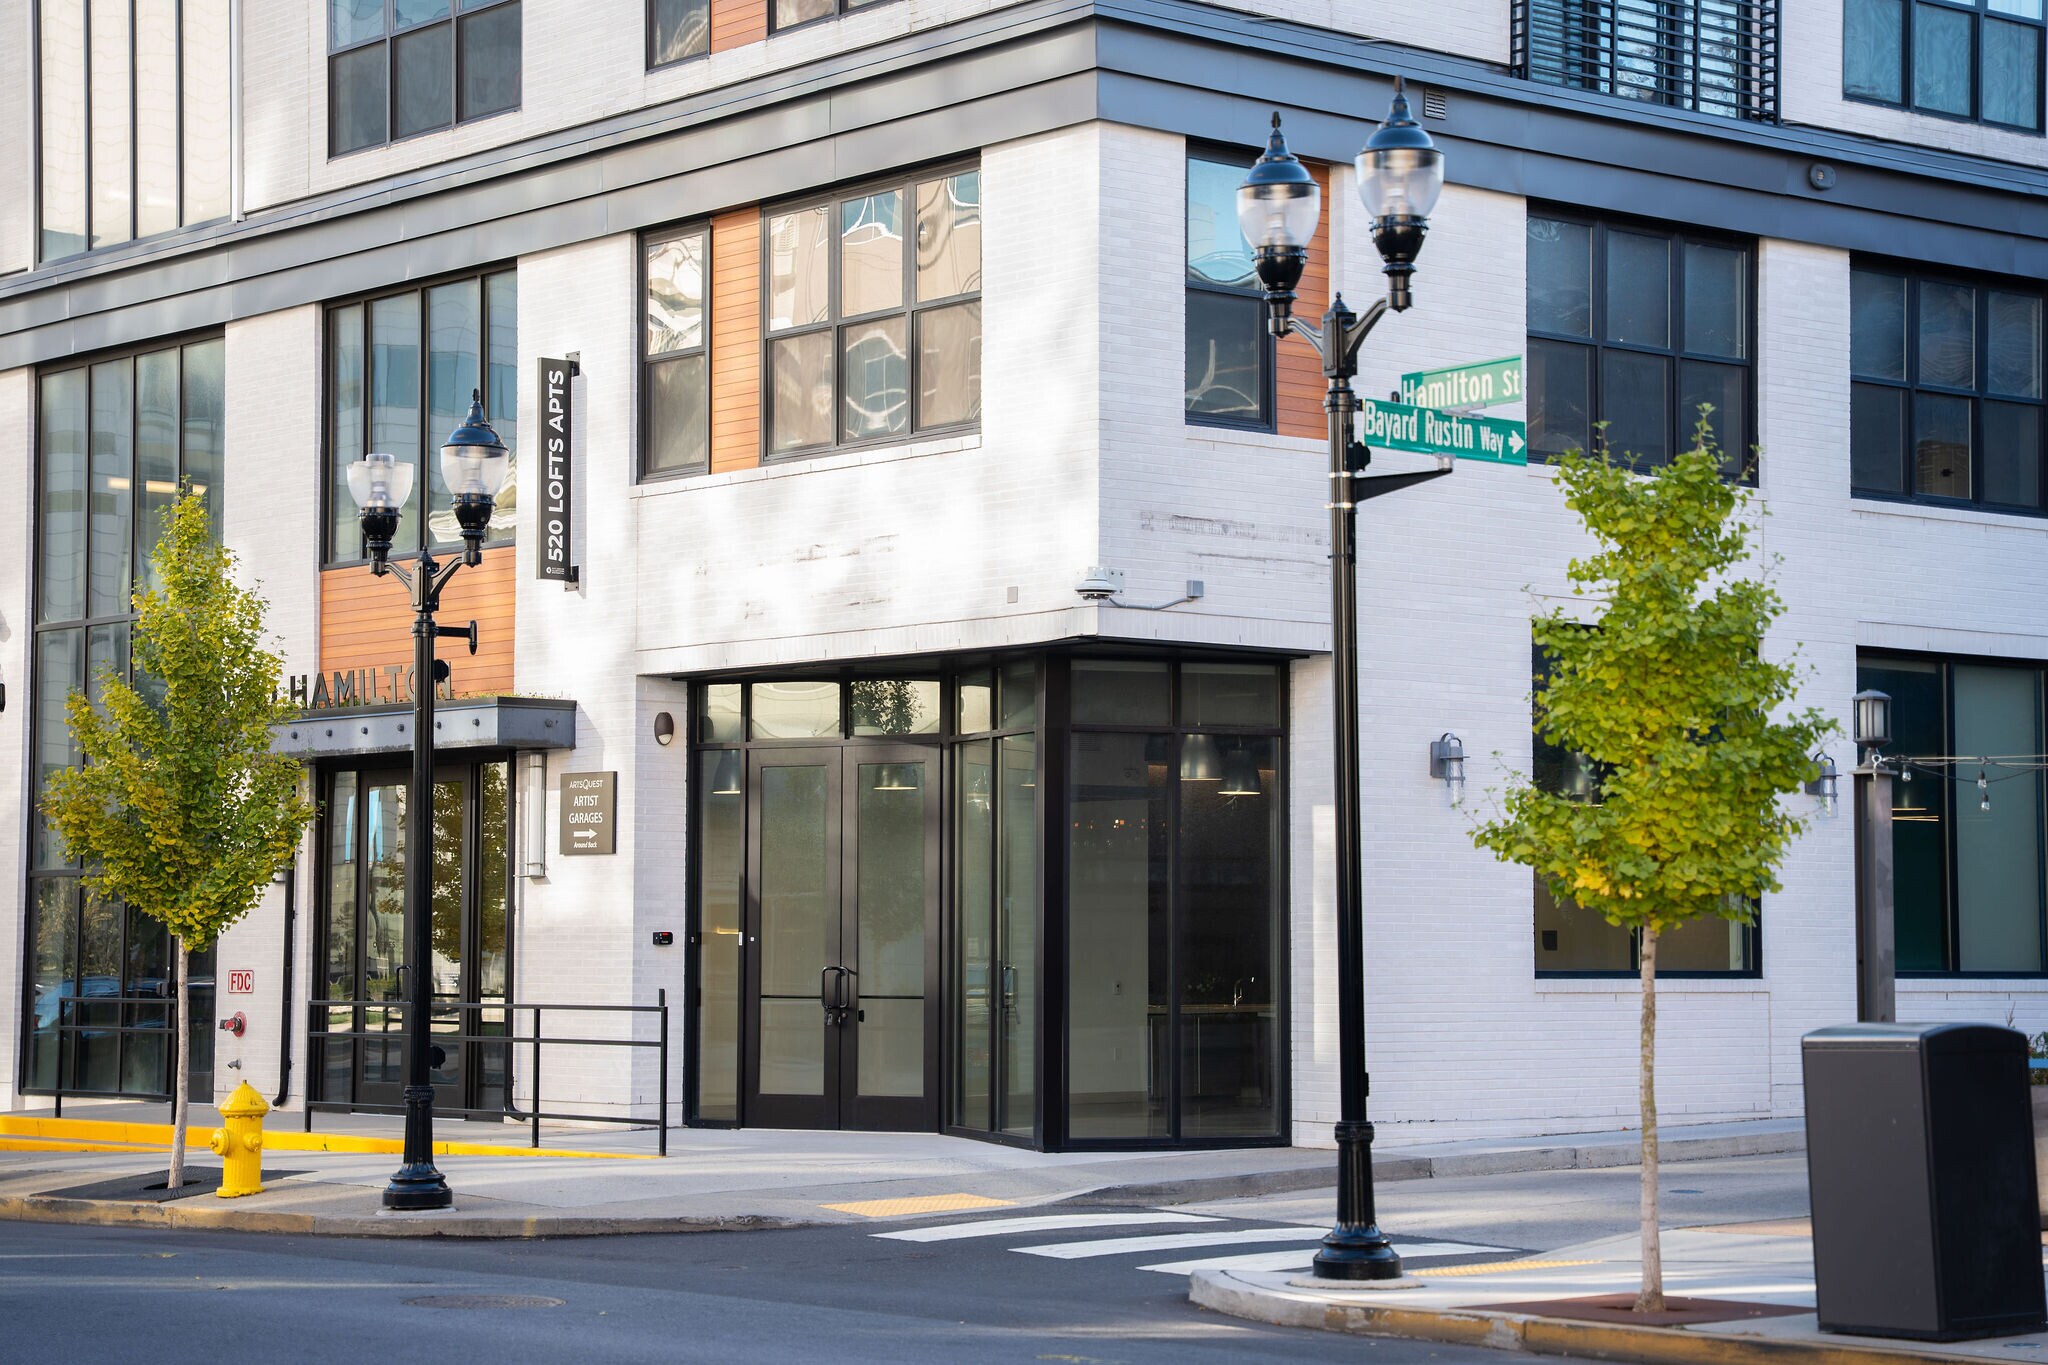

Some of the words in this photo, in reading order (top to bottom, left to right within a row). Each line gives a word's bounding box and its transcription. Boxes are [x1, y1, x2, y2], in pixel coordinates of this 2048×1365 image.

[548, 369, 565, 433] APTS
[1402, 371, 1494, 409] Hamilton
[1502, 369, 1521, 397] St
[1365, 401, 1418, 446] Bayard
[1425, 410, 1474, 449] Rustin
[1480, 426, 1504, 459] Way
[547, 438, 564, 513] LOFTS
[547, 519, 564, 563] 520
[568, 812, 603, 824] GARAGES
[573, 795, 599, 807] ARTIST
[230, 972, 251, 991] FDC
